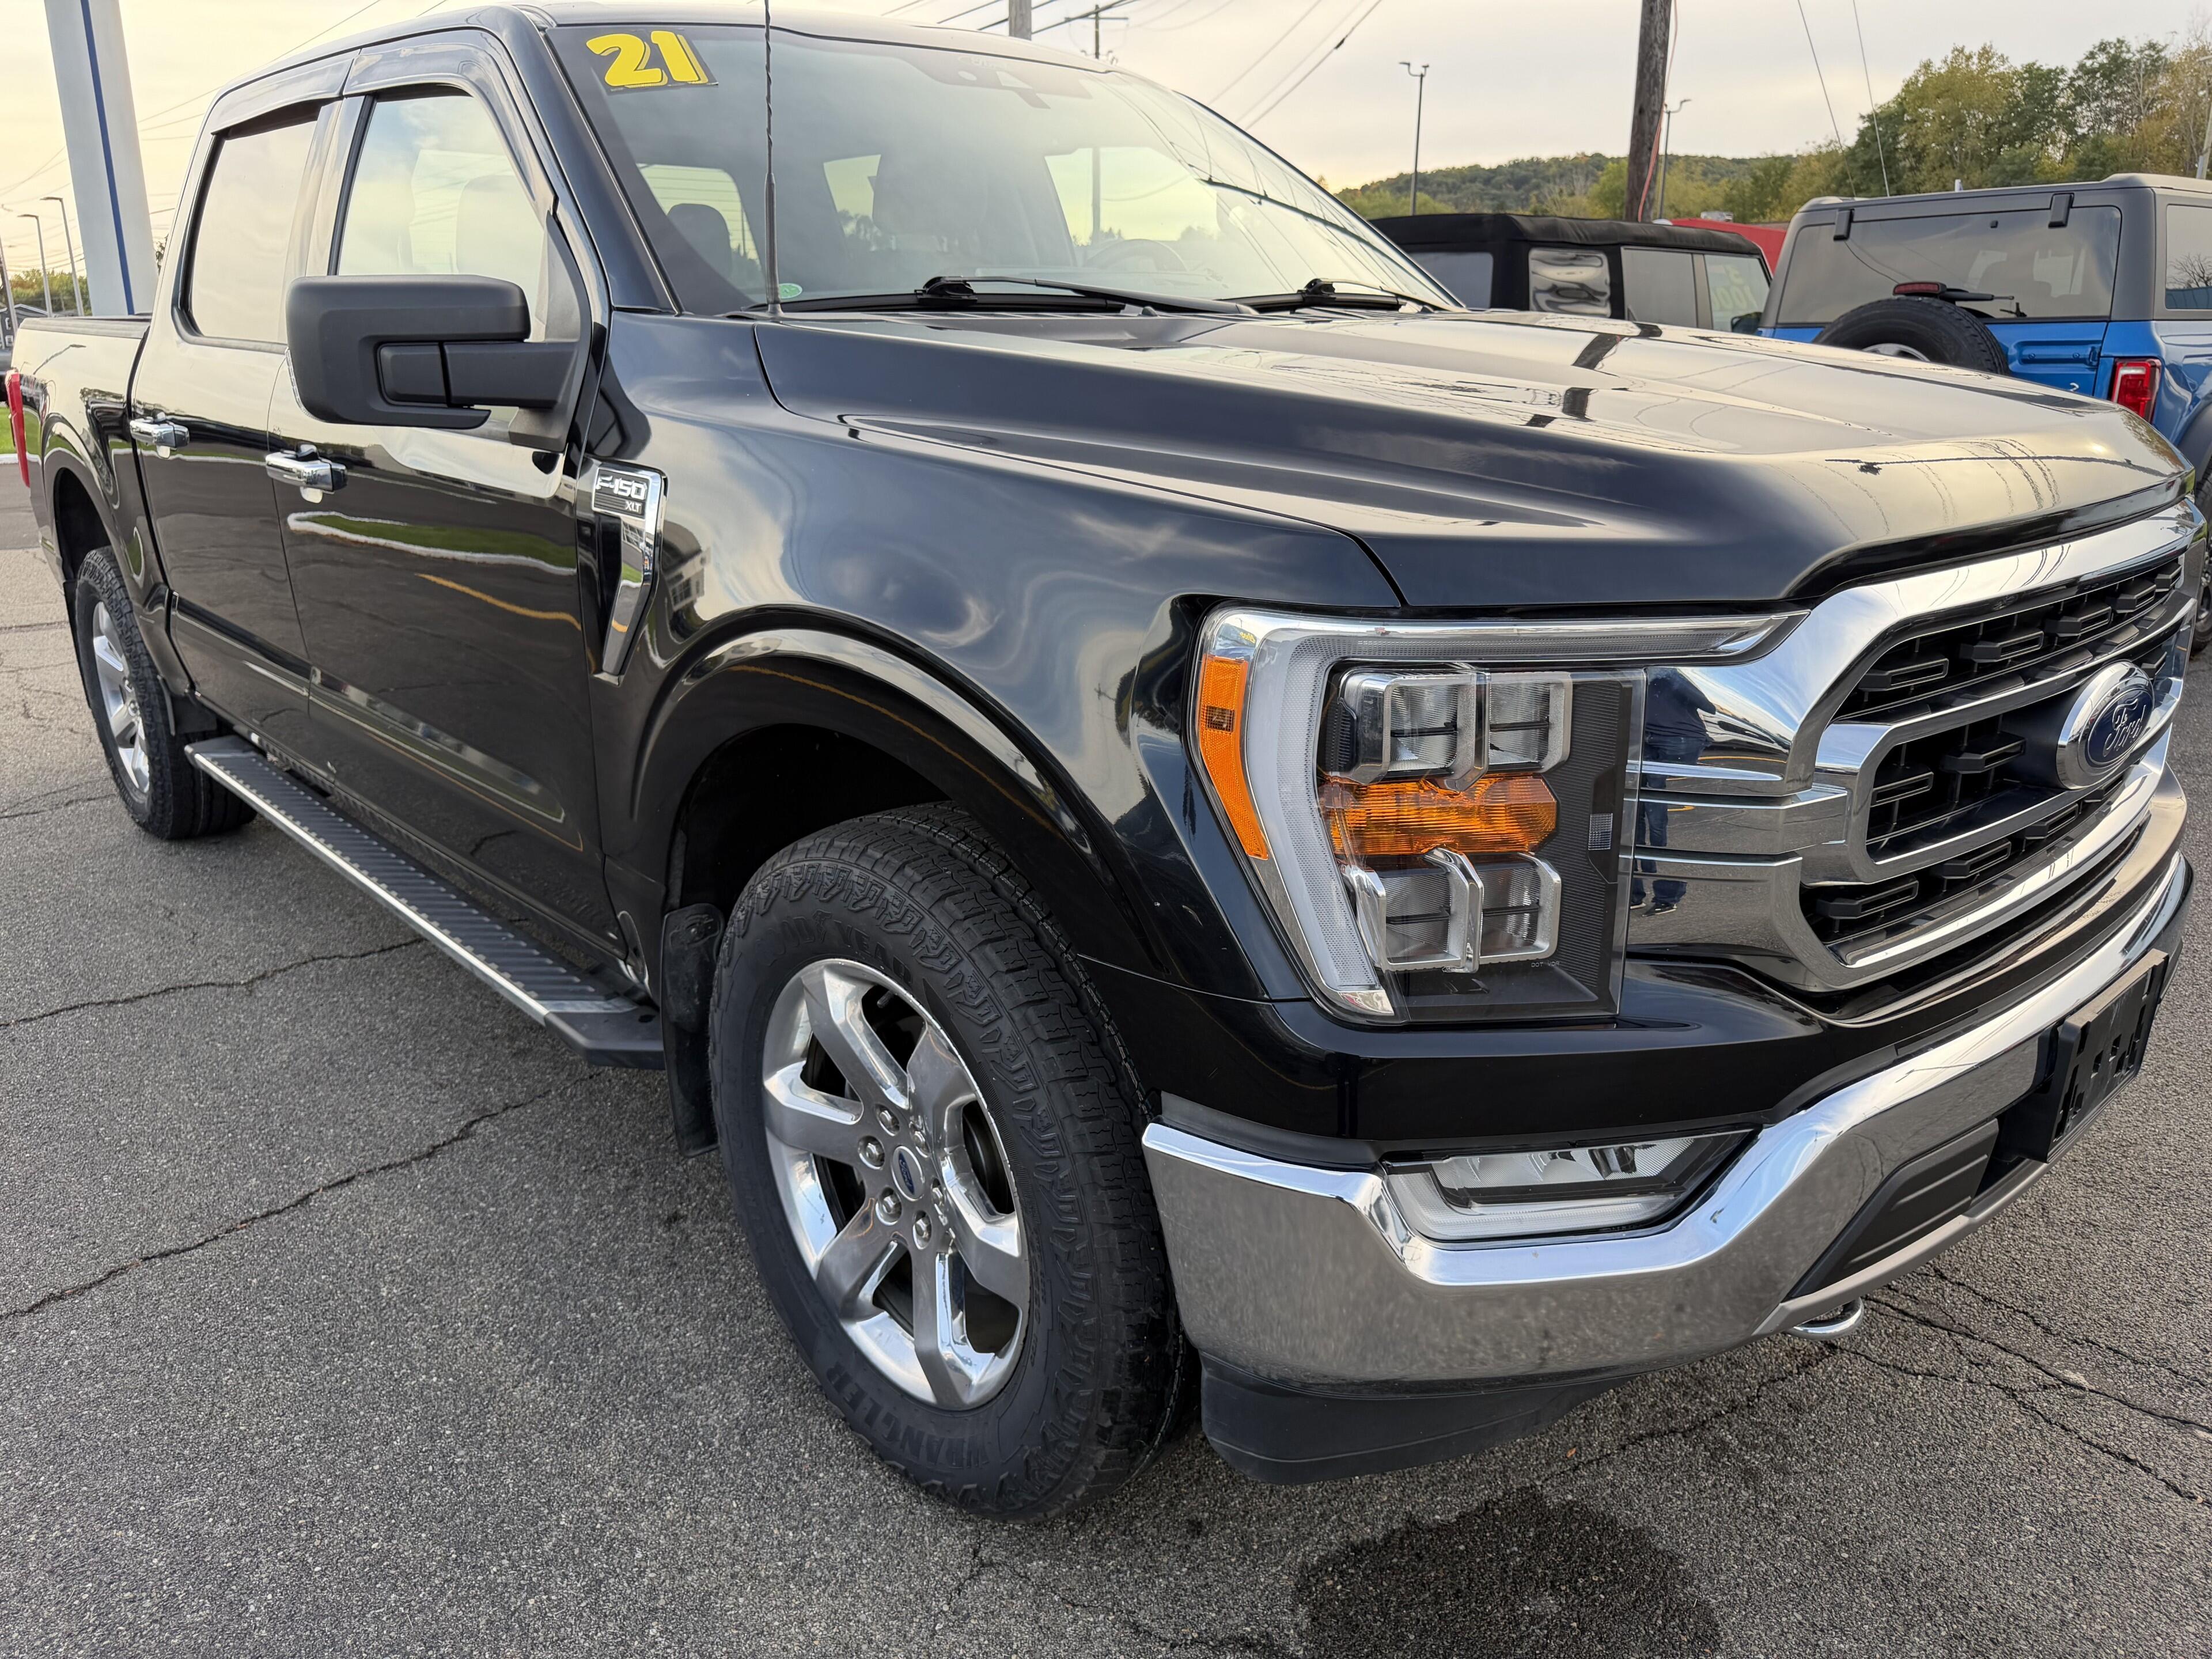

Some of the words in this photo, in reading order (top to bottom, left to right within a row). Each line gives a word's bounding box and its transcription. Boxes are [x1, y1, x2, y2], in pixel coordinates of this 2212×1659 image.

[586, 31, 708, 88] 21
[595, 475, 648, 501] F-150
[625, 501, 643, 514] XLT
[2103, 698, 2146, 757] Ford
